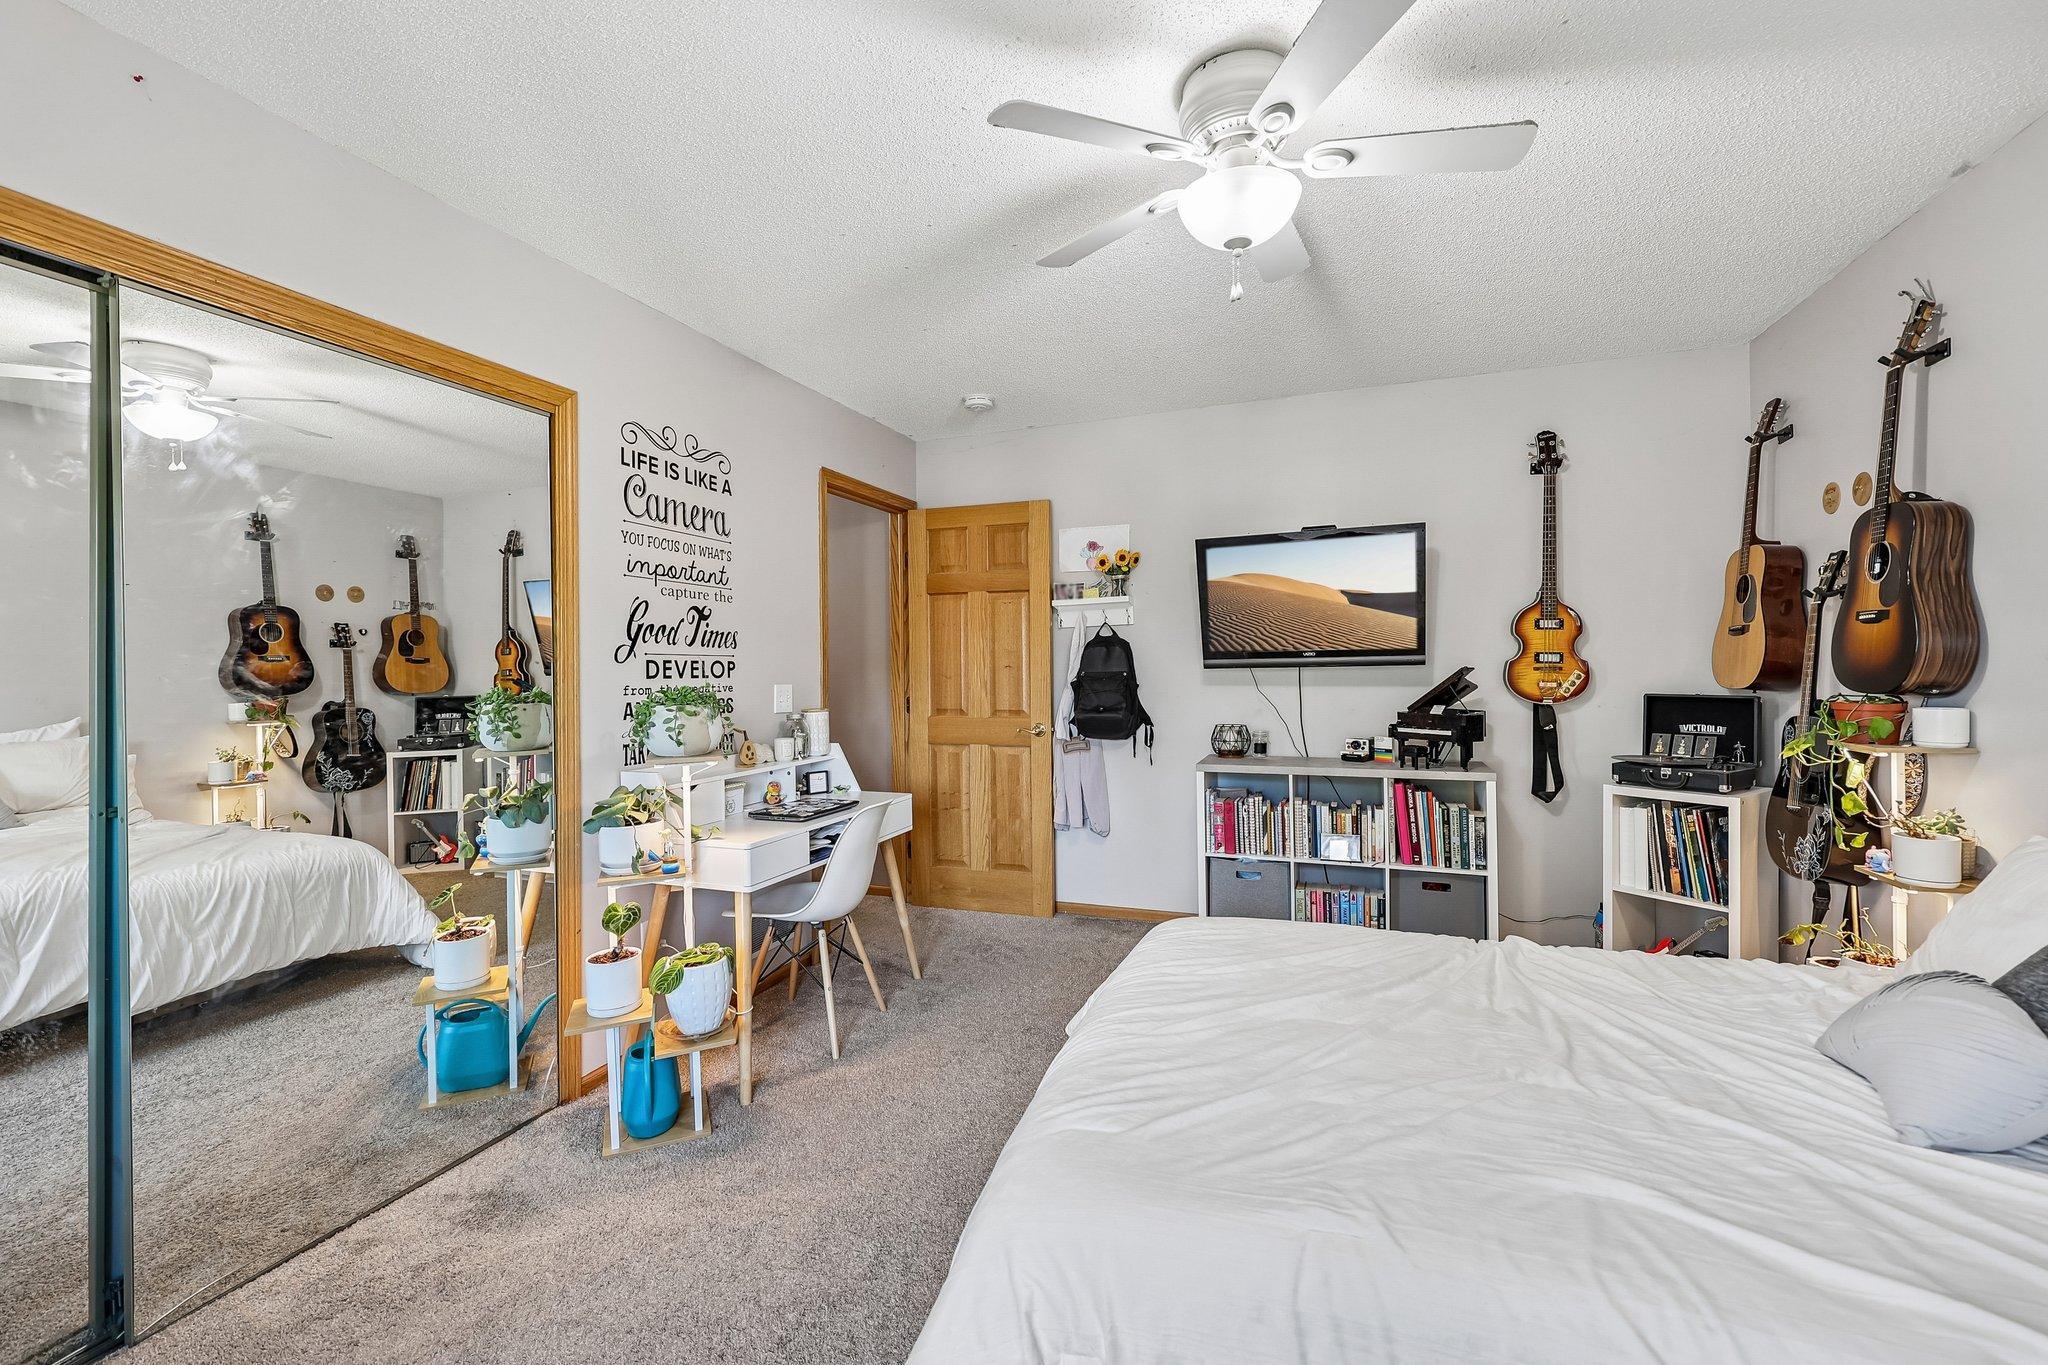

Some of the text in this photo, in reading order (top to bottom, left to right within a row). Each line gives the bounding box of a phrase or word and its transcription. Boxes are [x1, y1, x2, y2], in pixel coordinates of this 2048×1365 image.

[620, 447, 733, 497] LIFE IS LIKE A
[623, 473, 732, 538] Camera
[621, 529, 732, 562] YOU FOCUS ON WHAT'S
[627, 553, 729, 587] important
[660, 586, 733, 603] capture the
[614, 596, 739, 664] Good Times
[645, 659, 736, 680] DEVELOP
[623, 685, 652, 697] from
[1682, 723, 1723, 733] VICTROLA
